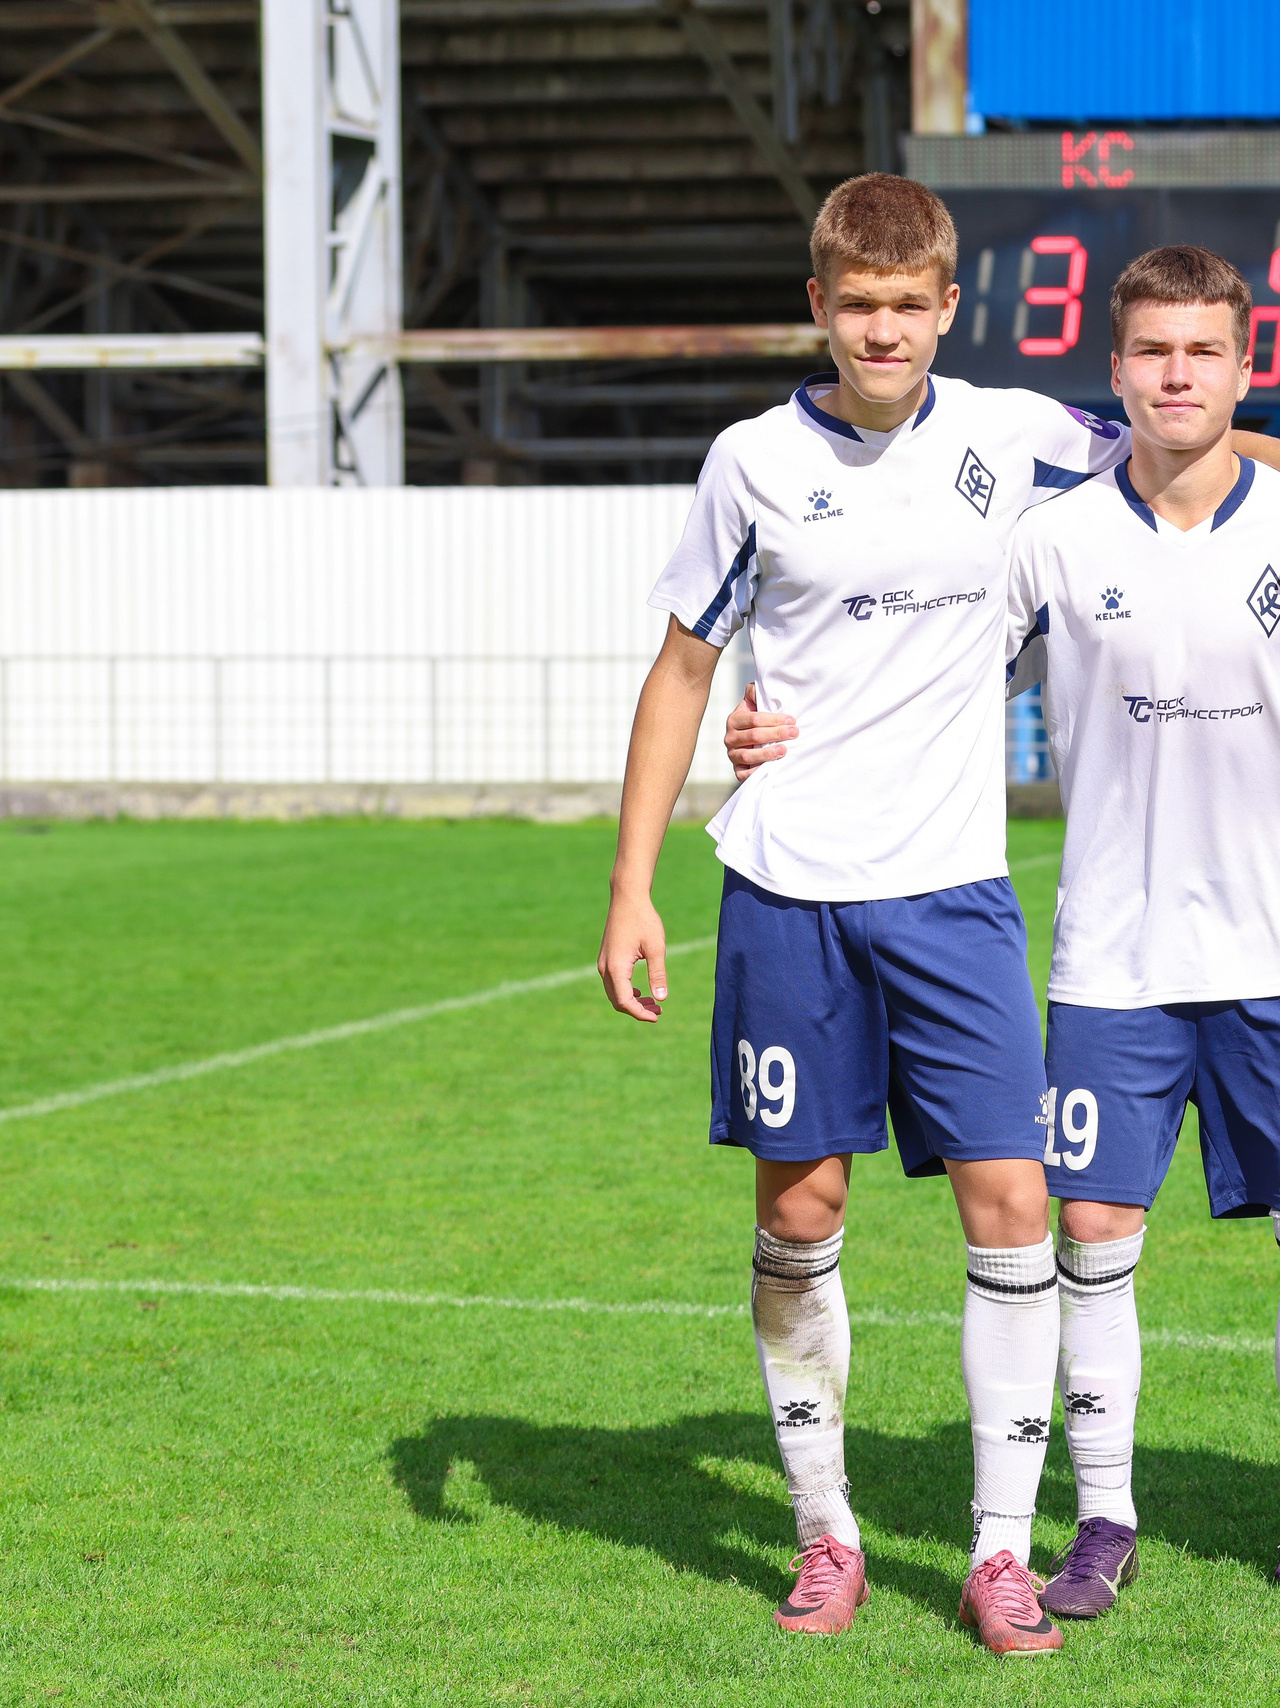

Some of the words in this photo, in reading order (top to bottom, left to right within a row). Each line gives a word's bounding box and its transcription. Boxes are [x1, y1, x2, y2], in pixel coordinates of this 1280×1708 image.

[803, 508, 844, 522] KELME
[881, 589, 914, 604] ДСК
[882, 588, 987, 616] ТРАНССТРОЙ
[1095, 610, 1132, 621] KELME
[1156, 696, 1185, 710] ДСК
[1157, 702, 1264, 723] ТРАНССТРОЙ
[737, 1038, 796, 1128] 89
[1043, 1086, 1099, 1171] 19
[1065, 1406, 1106, 1415] KELME
[776, 1417, 821, 1427] KELME
